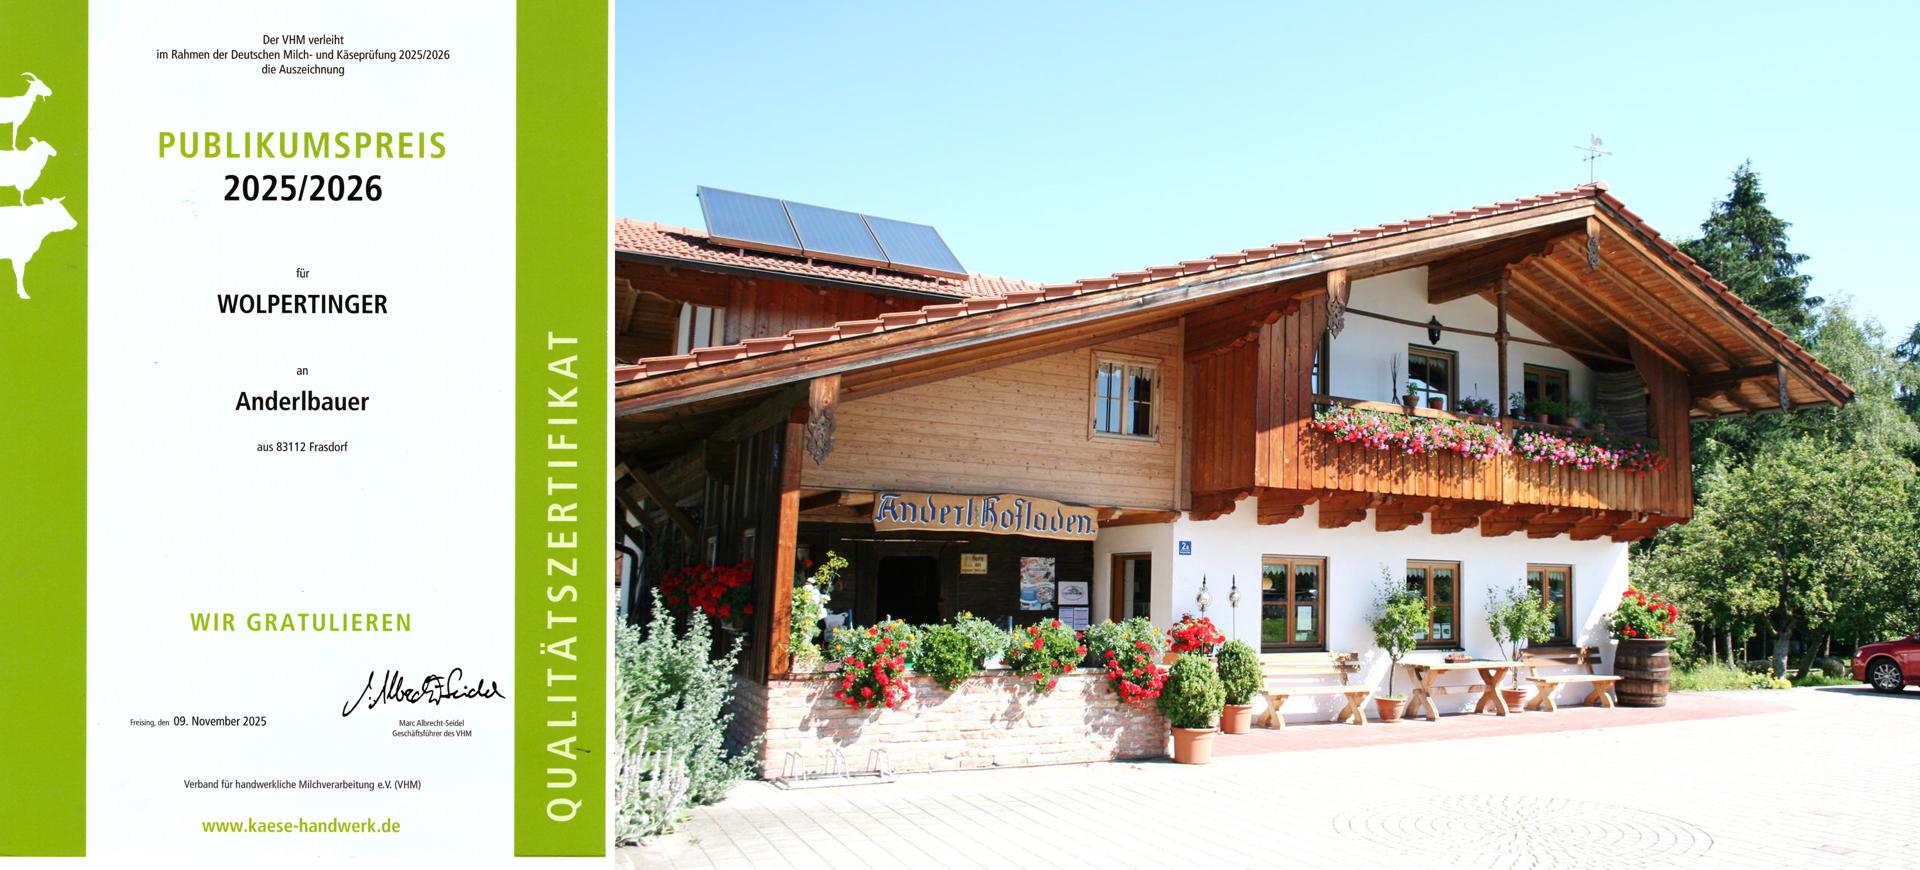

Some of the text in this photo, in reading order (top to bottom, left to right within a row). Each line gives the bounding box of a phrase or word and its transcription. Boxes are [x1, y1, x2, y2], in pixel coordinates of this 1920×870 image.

[262, 33, 345, 45] Der VHM verleiht
[156, 48, 451, 63] im Rahmen der Deutschen Milch- und Käseprüfung 2025/2026
[261, 63, 345, 78] die Auszeichnung
[159, 131, 446, 159] PUBLIKUMSPREIS
[224, 175, 382, 201] 2025/2026
[295, 267, 311, 279] für
[217, 294, 387, 314] WOLPERTINGER
[296, 367, 309, 376] an
[235, 390, 369, 411] Anderlbauer
[256, 440, 349, 453] aus 83112 Frasdorf
[874, 493, 974, 527] Anderl
[540, 331, 583, 822] QUALITÄTSZERTIFIKAT
[190, 612, 410, 632] WIR GRATULIEREN
[129, 715, 267, 728] Freising, den 09. November 2025
[398, 719, 465, 727] Marc Albrecht-Seidel
[391, 729, 473, 738] Geschäftsführer des VHM
[183, 778, 422, 792] Verband für handwerkliche Milchverarbeitung e.V. (VHM)
[202, 817, 400, 833] www.kaese-handwerk.de
